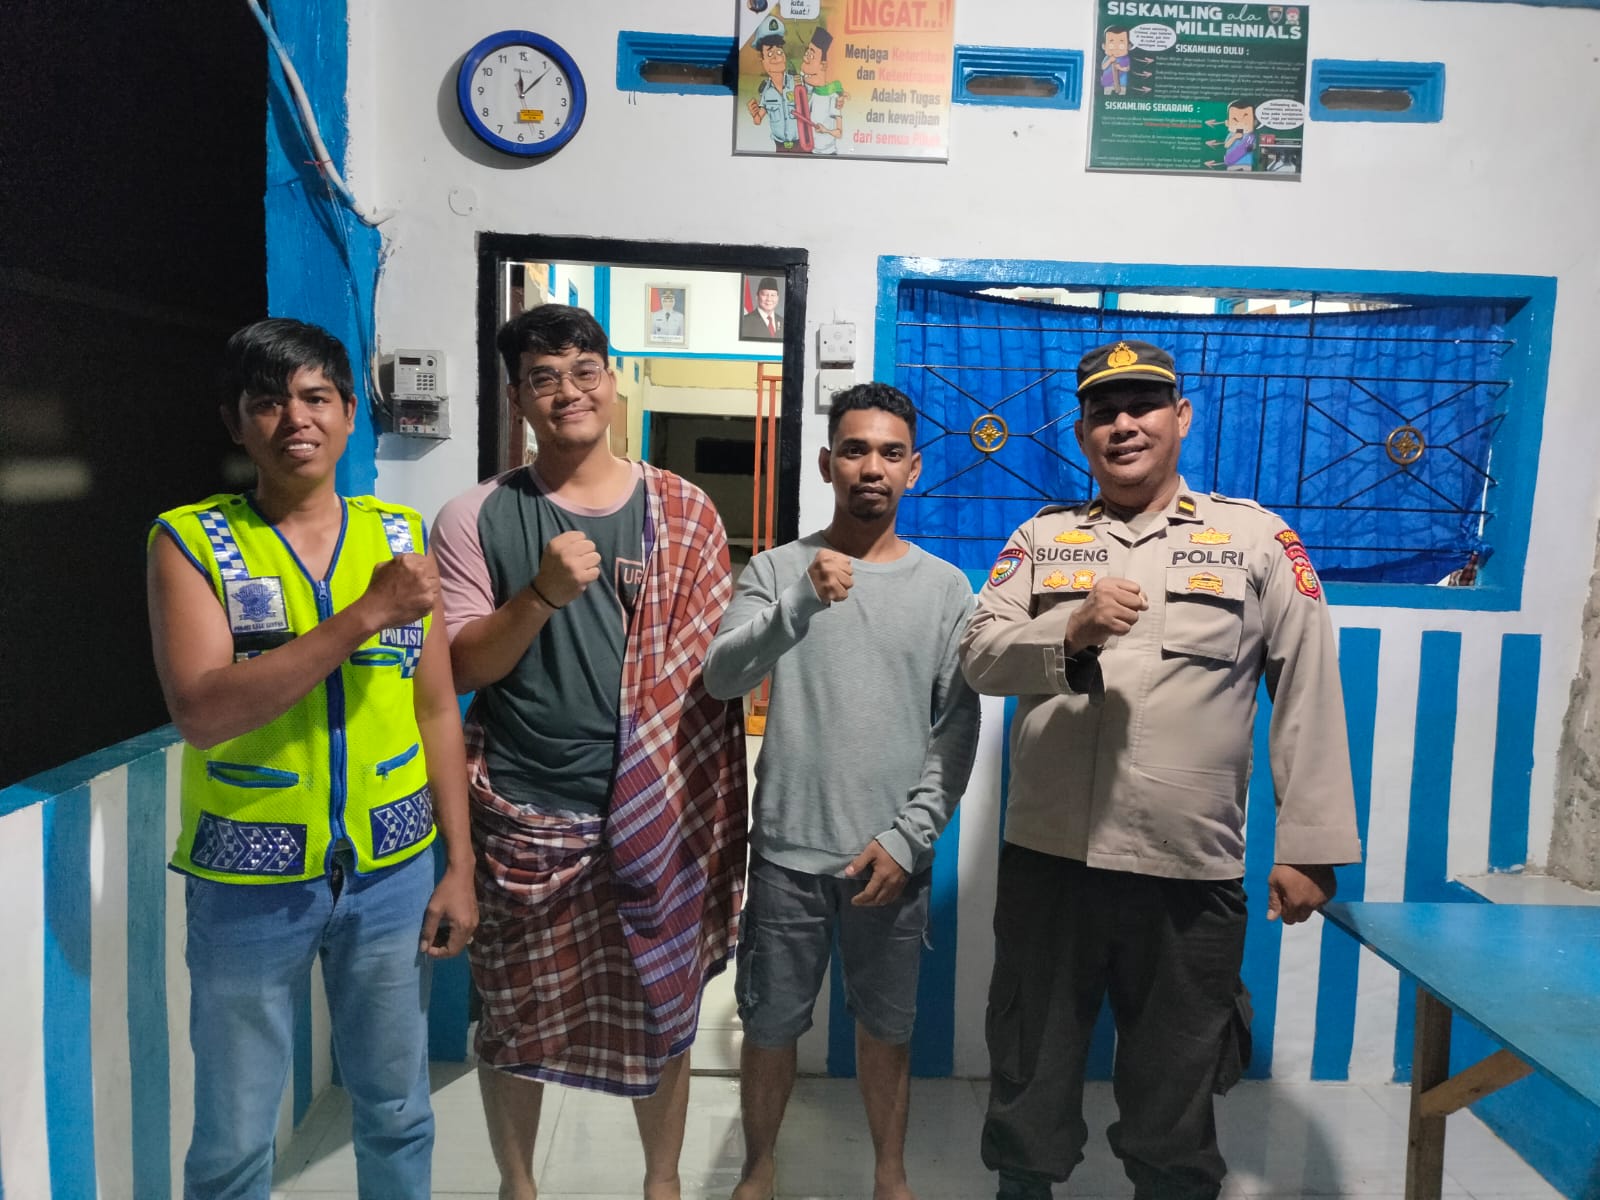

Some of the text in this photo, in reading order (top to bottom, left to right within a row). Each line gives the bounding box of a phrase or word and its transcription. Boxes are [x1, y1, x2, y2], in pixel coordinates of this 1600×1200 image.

[1107, 2, 1262, 21] SISKAMLING ala
[1175, 21, 1302, 39] MILLENNIALS
[845, 43, 888, 63] Menjaga
[1175, 44, 1221, 55] SISKAMLING
[1223, 46, 1244, 56] DULU
[498, 55, 507, 64] 11
[542, 61, 548, 69] 1
[482, 68, 493, 76] 10
[856, 66, 875, 80] dan
[555, 77, 562, 86] 2
[477, 87, 485, 95] 9
[561, 98, 567, 107] 3
[871, 88, 941, 108] Adalah Tugas
[482, 108, 489, 117] 8
[1105, 101, 1151, 111] SISKAMLING
[1153, 104, 1194, 113] SEKARANG
[554, 117, 560, 126] 4
[866, 109, 940, 128] dan kewajiban
[497, 125, 504, 134] 7
[539, 130, 545, 139] 5
[517, 133, 524, 142] 6
[853, 130, 872, 143] dari
[876, 133, 909, 145] semua
[1036, 548, 1109, 563] SUGENG
[1171, 549, 1244, 567] POLRI
[381, 628, 422, 647] POLISI
